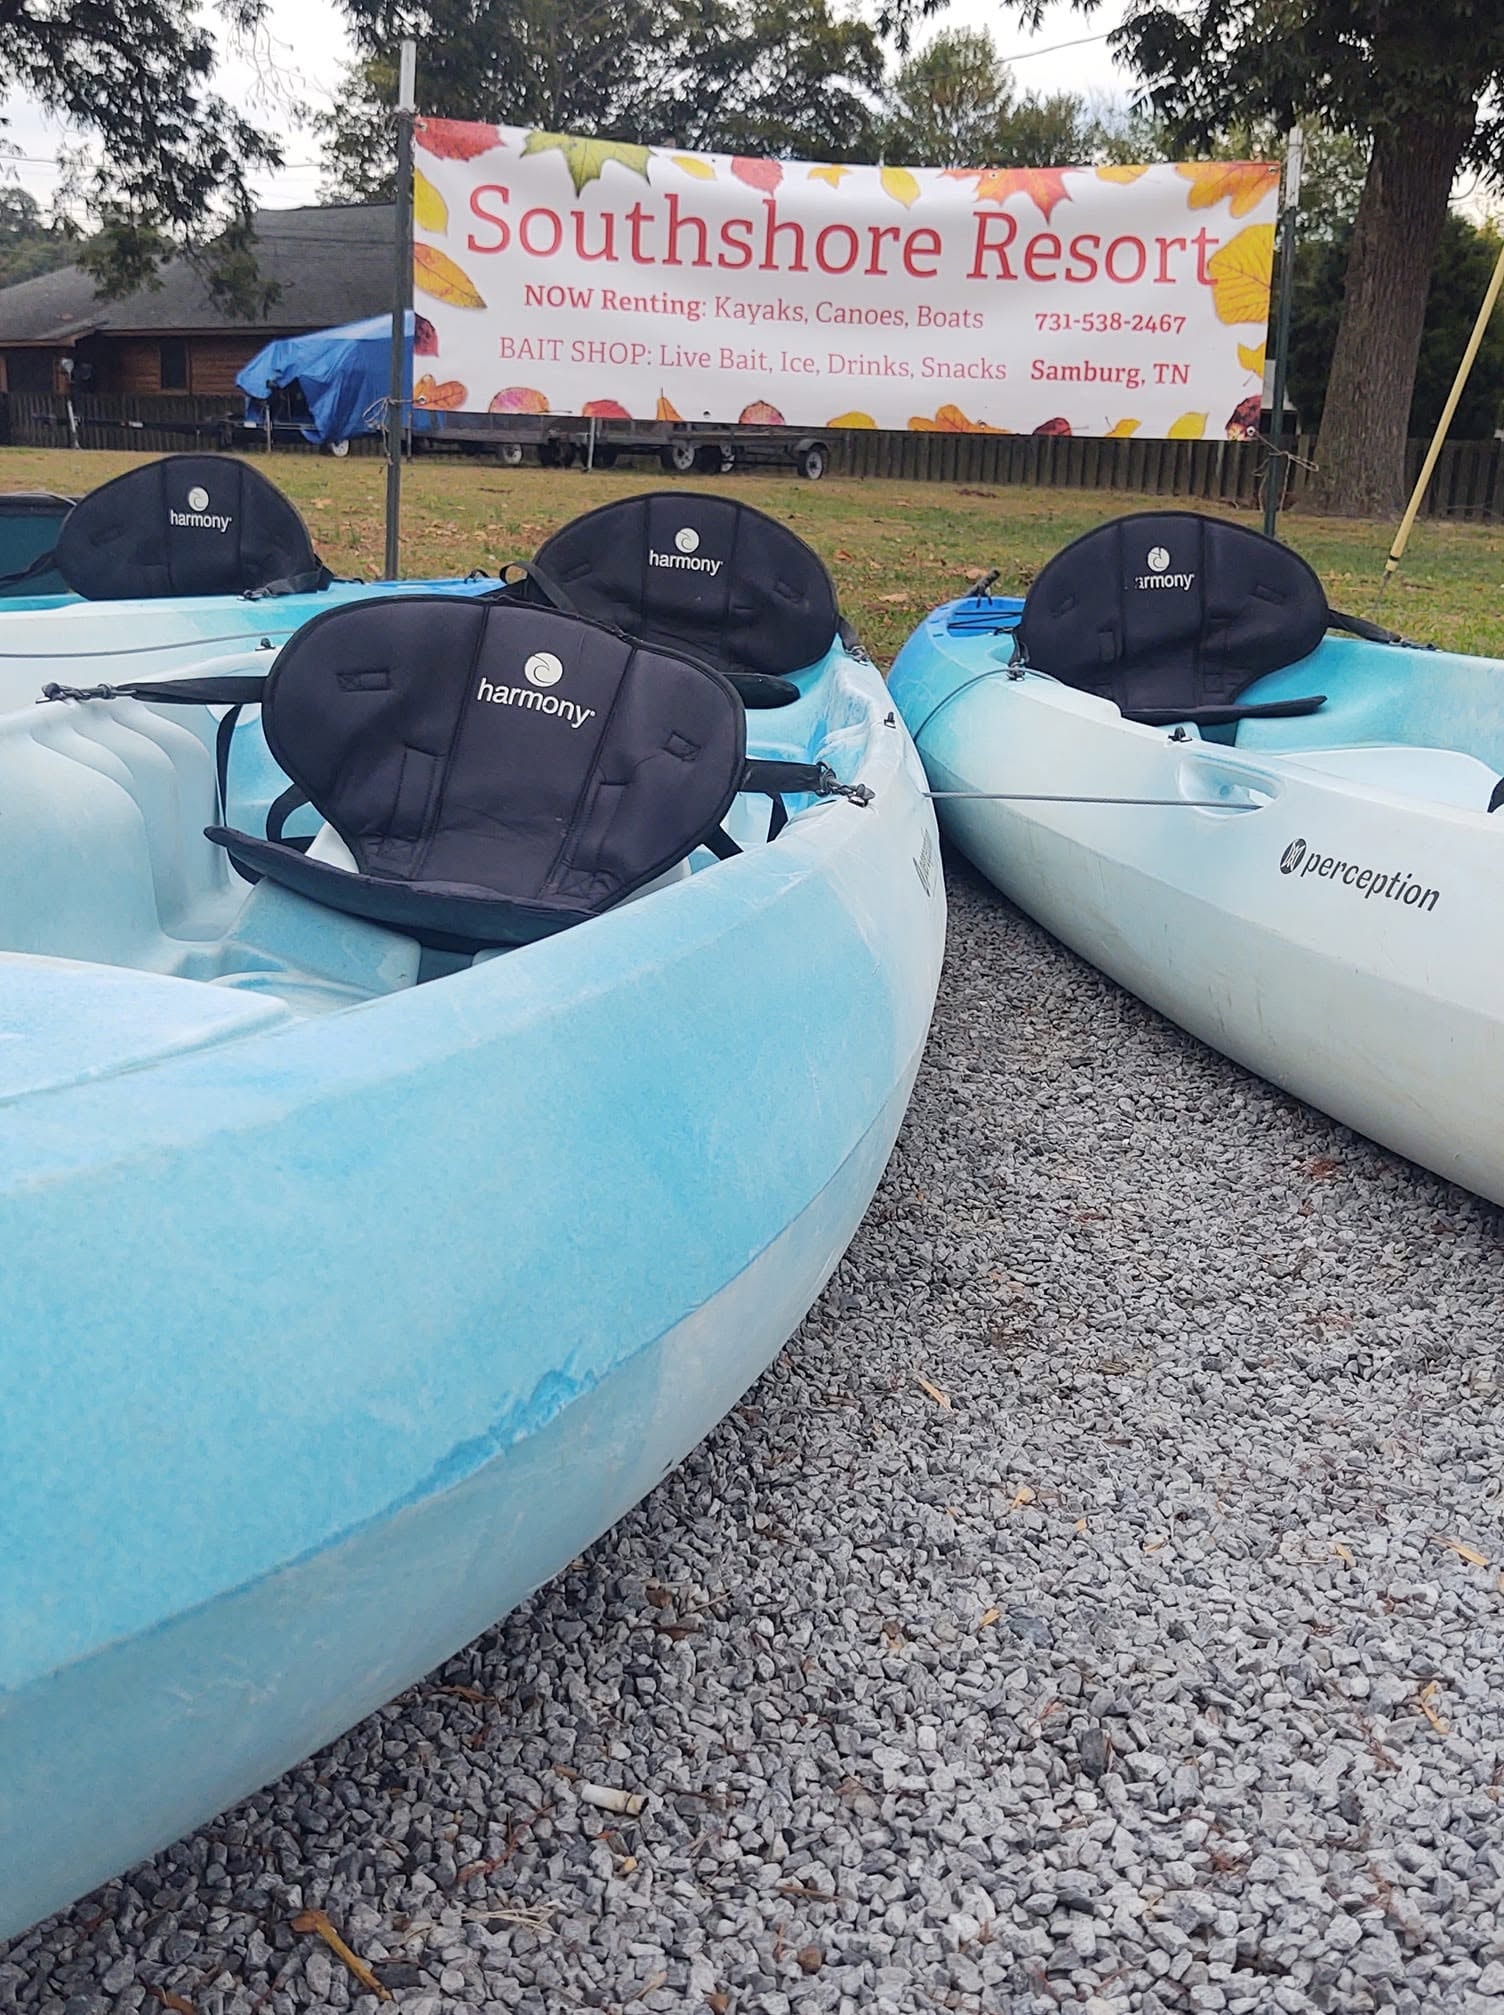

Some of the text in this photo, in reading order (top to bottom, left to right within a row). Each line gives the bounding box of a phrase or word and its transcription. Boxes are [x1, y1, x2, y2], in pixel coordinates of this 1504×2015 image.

[467, 184, 1220, 287] Southshore Resort
[524, 284, 984, 329] NOW Renting: Kayaks, Canoes, Boats
[1035, 312, 1187, 335] 731-538-2467
[500, 336, 1007, 380] BAIT SHOP: Live Bait, Ice, Drinks, Snacks
[1031, 359, 1190, 389] Samburg, TN
[170, 509, 231, 533] harmony
[649, 550, 722, 577] harmony
[1131, 573, 1194, 591] armony
[477, 677, 595, 729] harmony
[1300, 852, 1440, 912] perception
